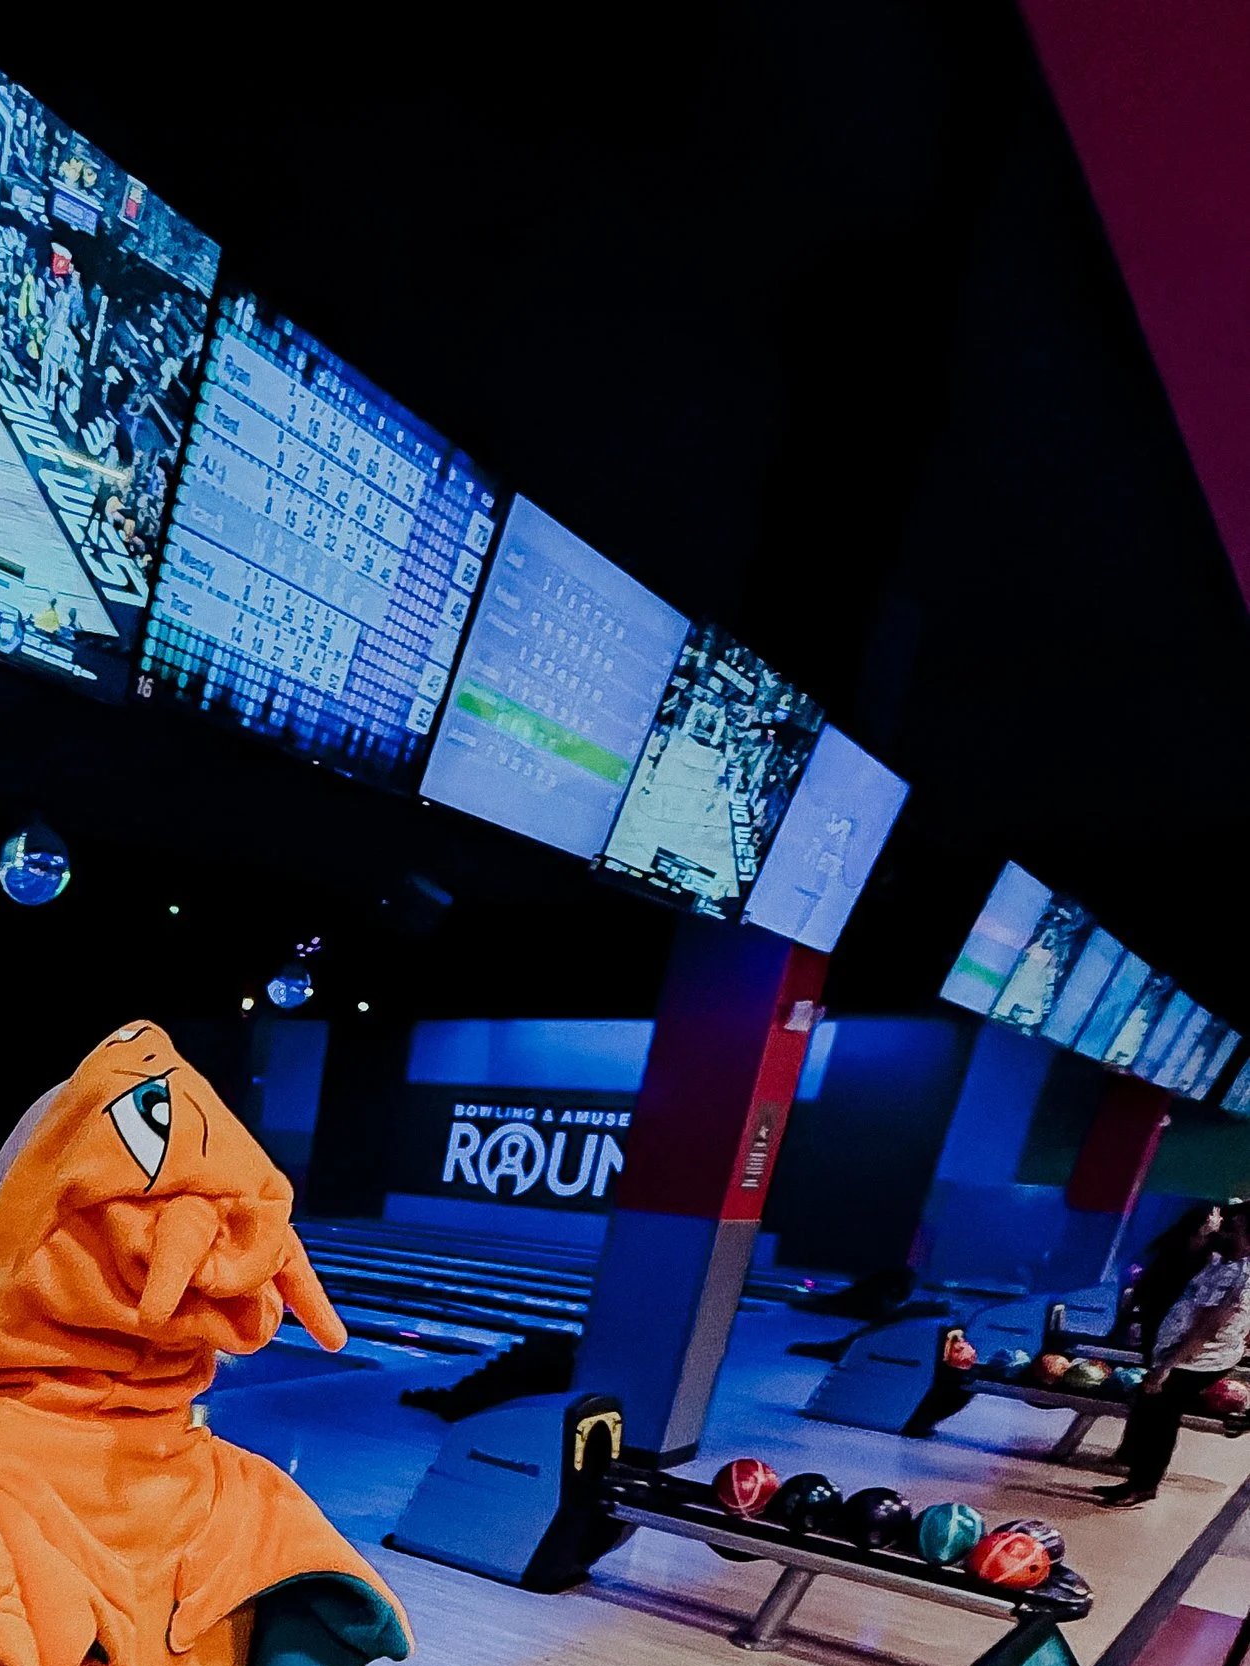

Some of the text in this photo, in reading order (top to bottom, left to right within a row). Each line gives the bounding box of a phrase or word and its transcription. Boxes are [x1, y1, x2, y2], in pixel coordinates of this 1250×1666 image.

[137, 675, 154, 698] 16
[454, 1104, 632, 1127] BOWLING & AMUSE
